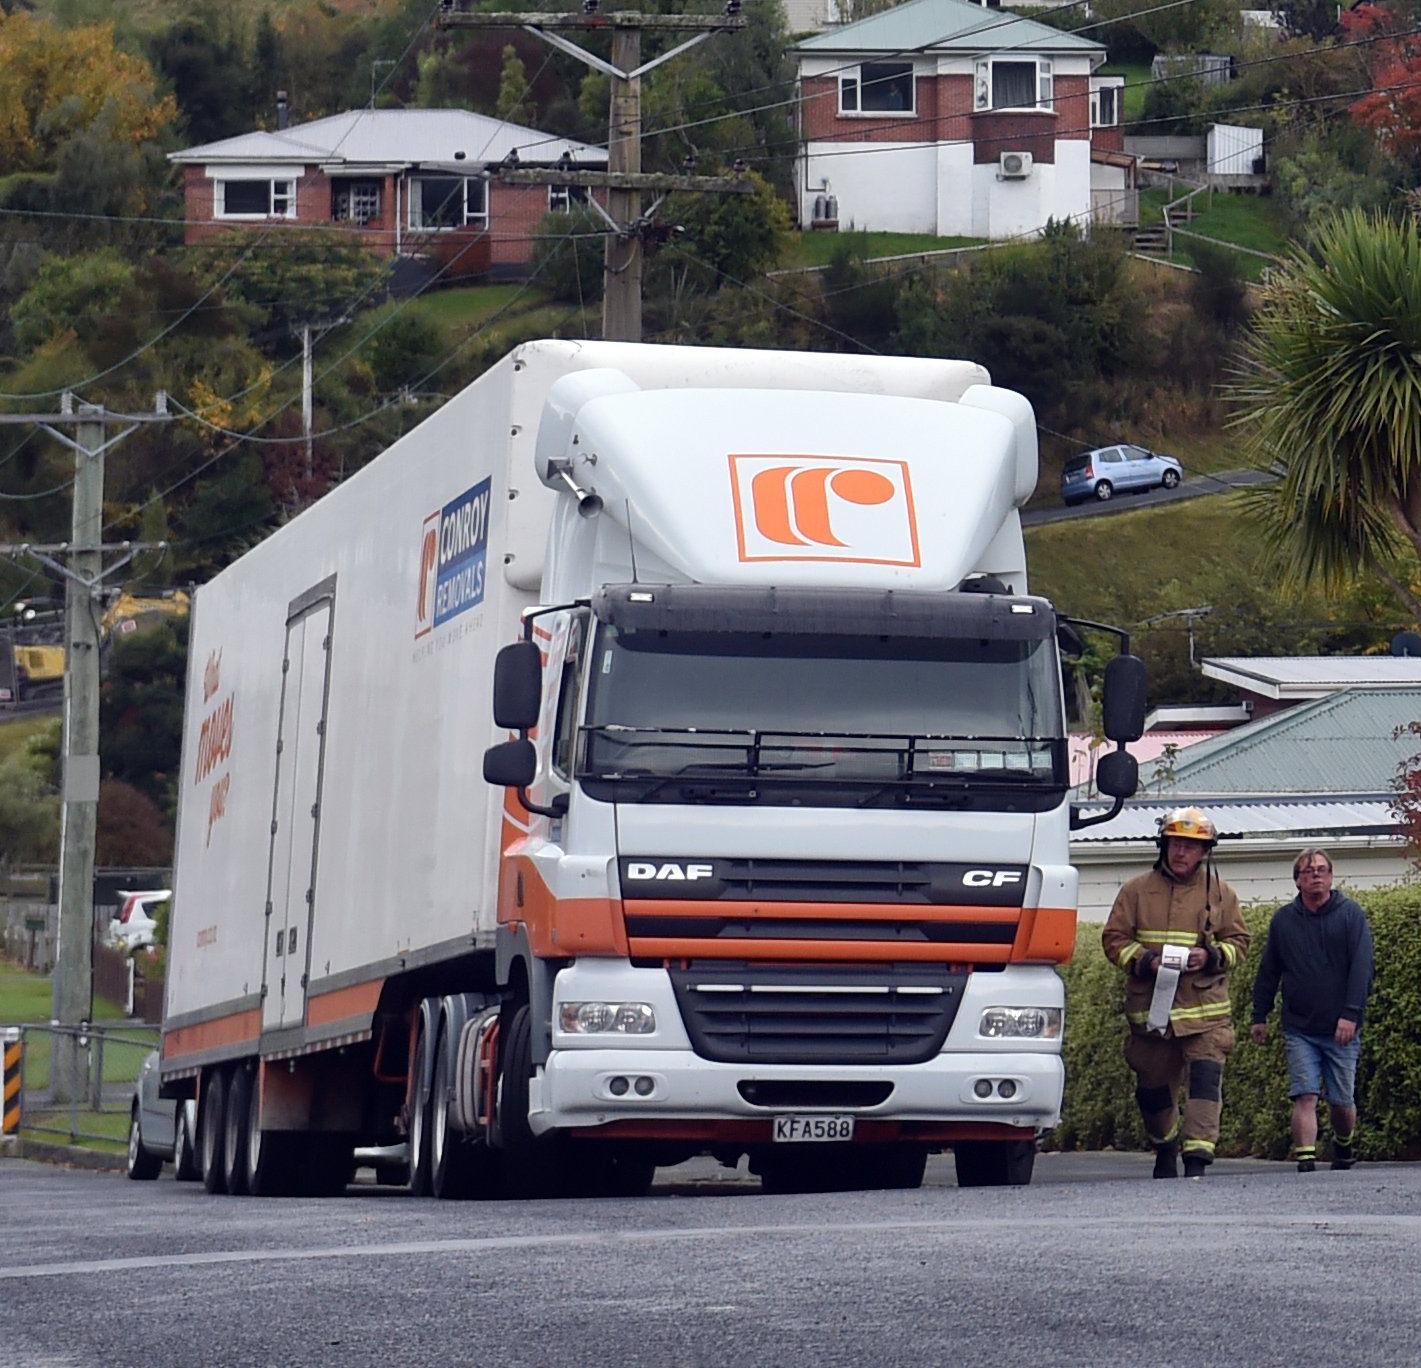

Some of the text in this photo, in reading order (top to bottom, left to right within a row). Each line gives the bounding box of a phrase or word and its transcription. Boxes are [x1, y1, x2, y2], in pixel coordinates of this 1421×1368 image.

[440, 490, 489, 564] CONROY
[435, 560, 483, 618] REMOVALS
[627, 863, 713, 880] DAF
[962, 870, 1022, 886] CF
[777, 1120, 850, 1138] KFA588
